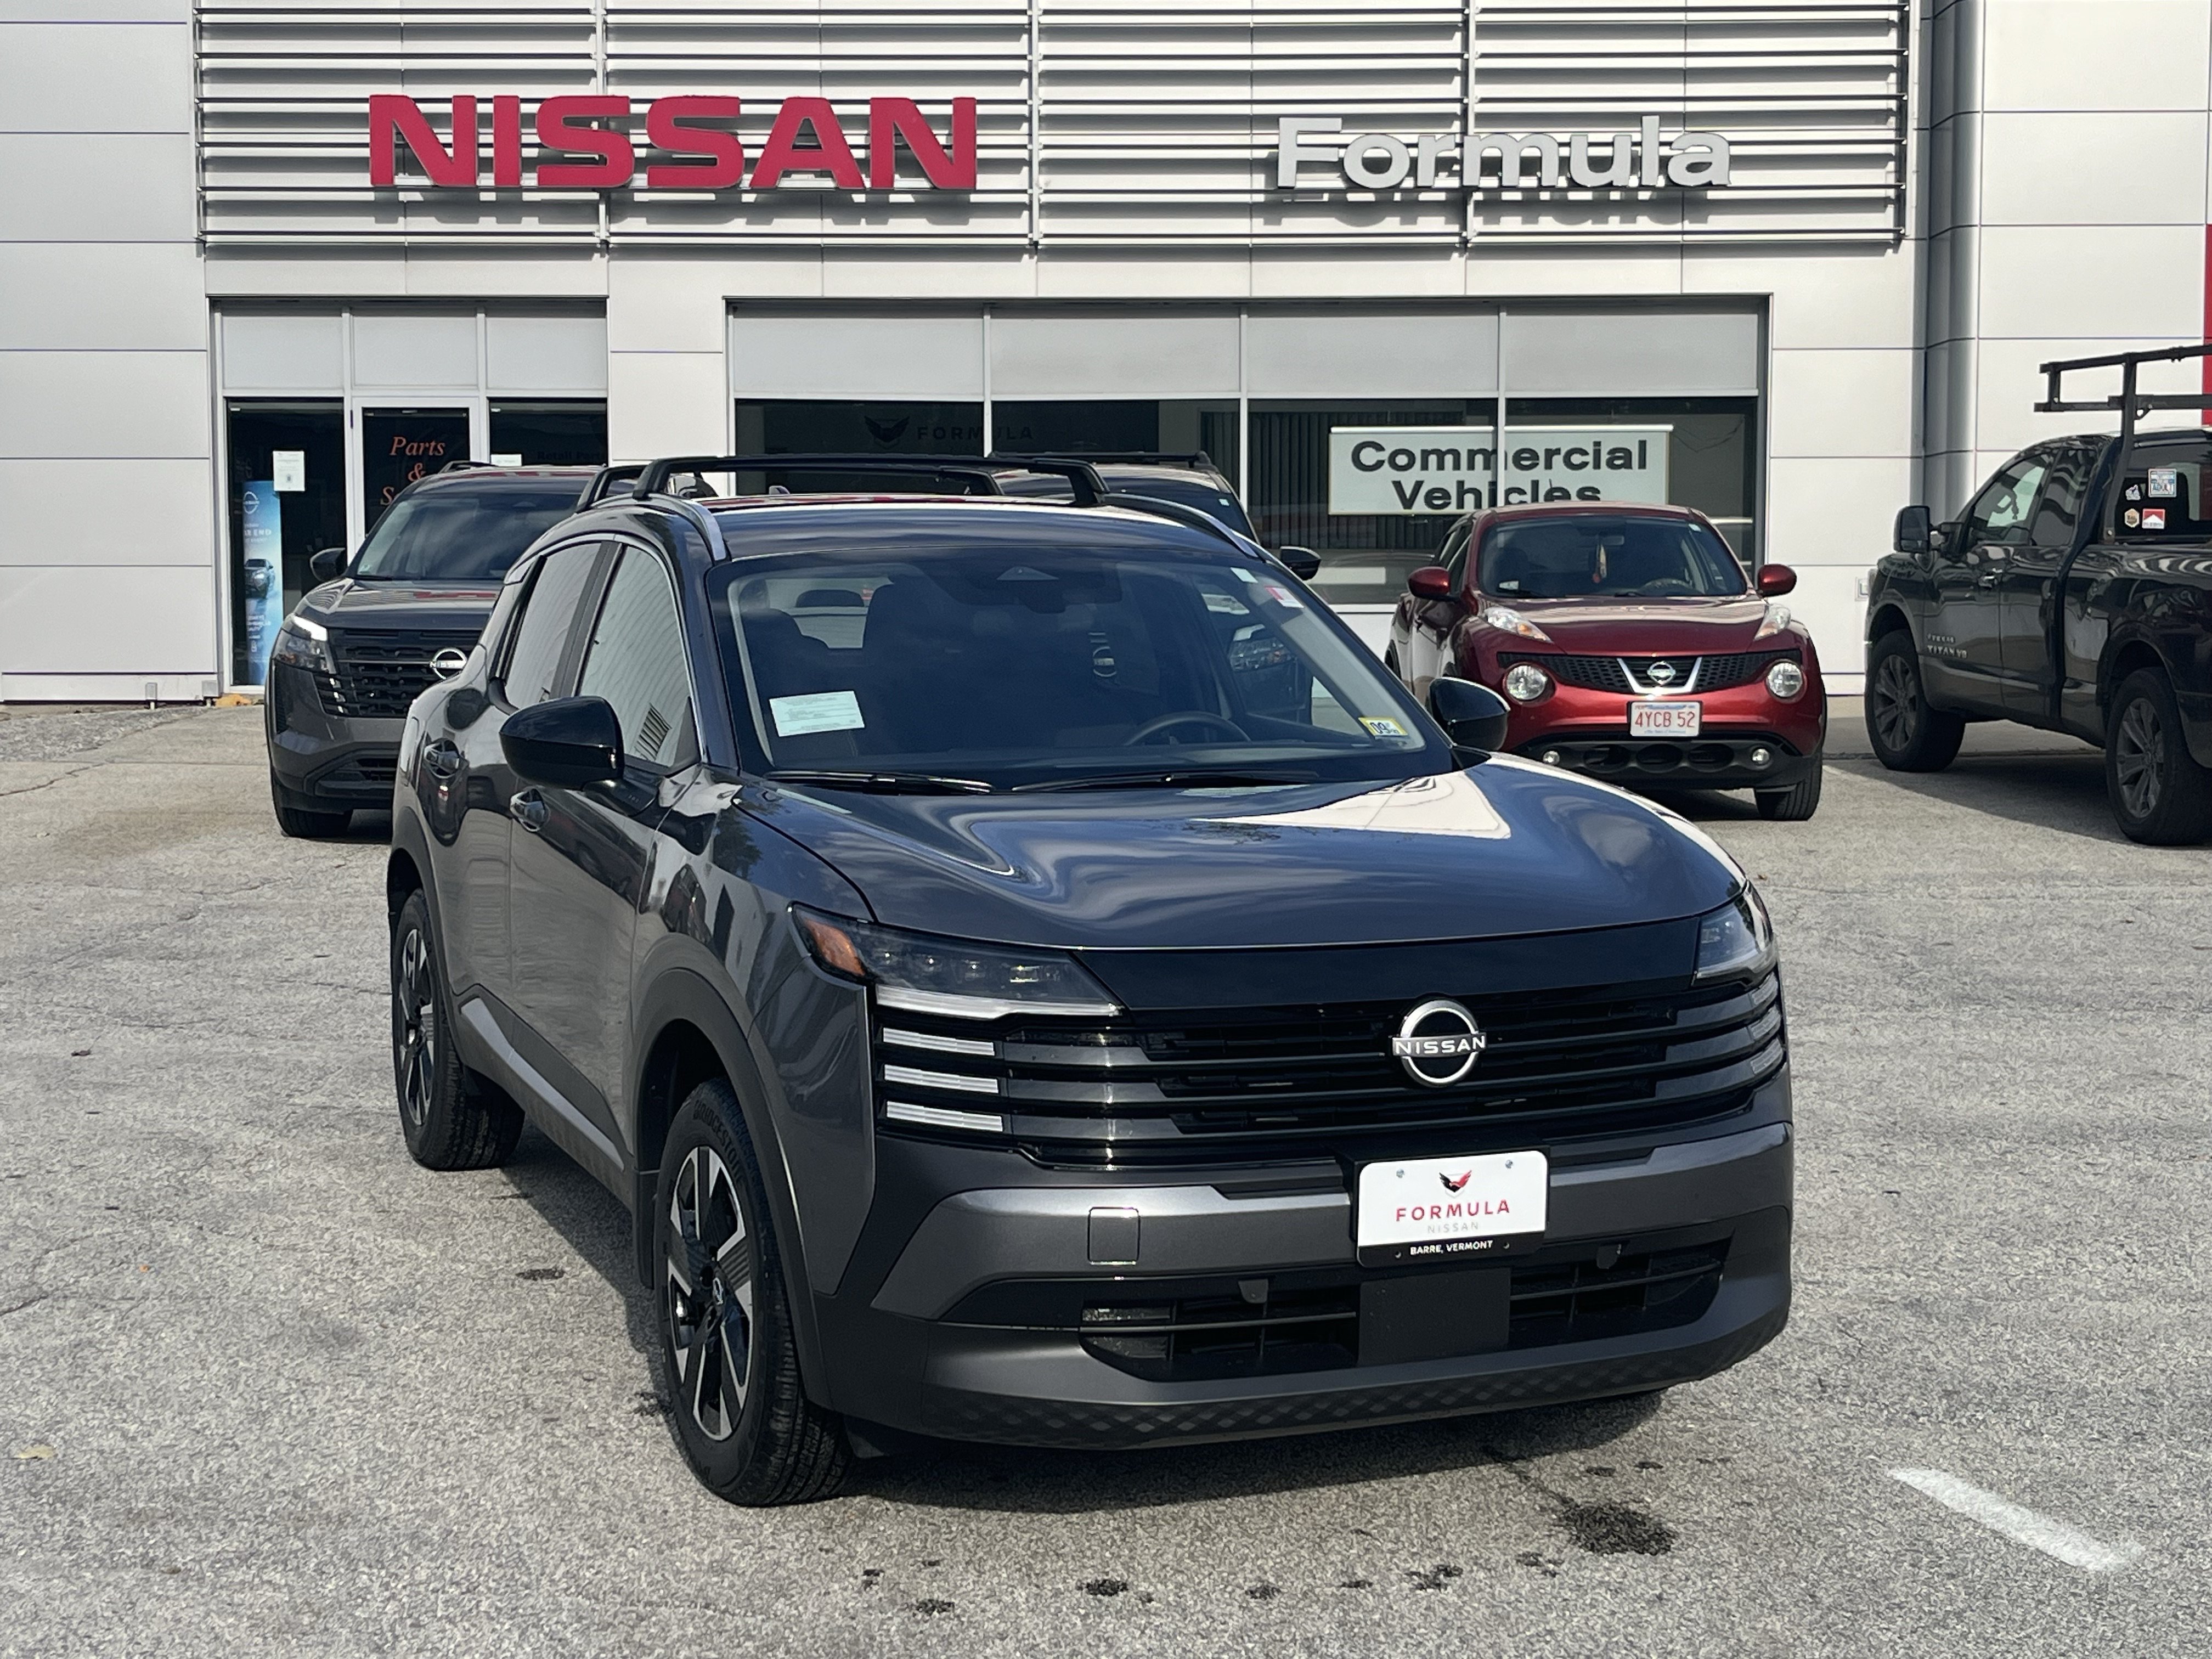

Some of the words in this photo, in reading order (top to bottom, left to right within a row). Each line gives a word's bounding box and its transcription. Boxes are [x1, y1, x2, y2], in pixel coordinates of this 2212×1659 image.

[369, 94, 977, 189] NISSAN
[1277, 115, 1732, 189] Formula
[389, 436, 446, 456] Parts
[1351, 439, 1647, 472] Commercial
[408, 462, 426, 482] &
[1391, 479, 1601, 510] Vehicles
[1635, 711, 1672, 728] 4YCB
[1677, 711, 1695, 728] 52
[1395, 1035, 1486, 1054] NISSAN
[1396, 1199, 1510, 1222] FORMULA
[1427, 1221, 1479, 1234] NISSAN
[1410, 1244, 1444, 1256] BARRE,
[1446, 1240, 1494, 1252] VERMONT
